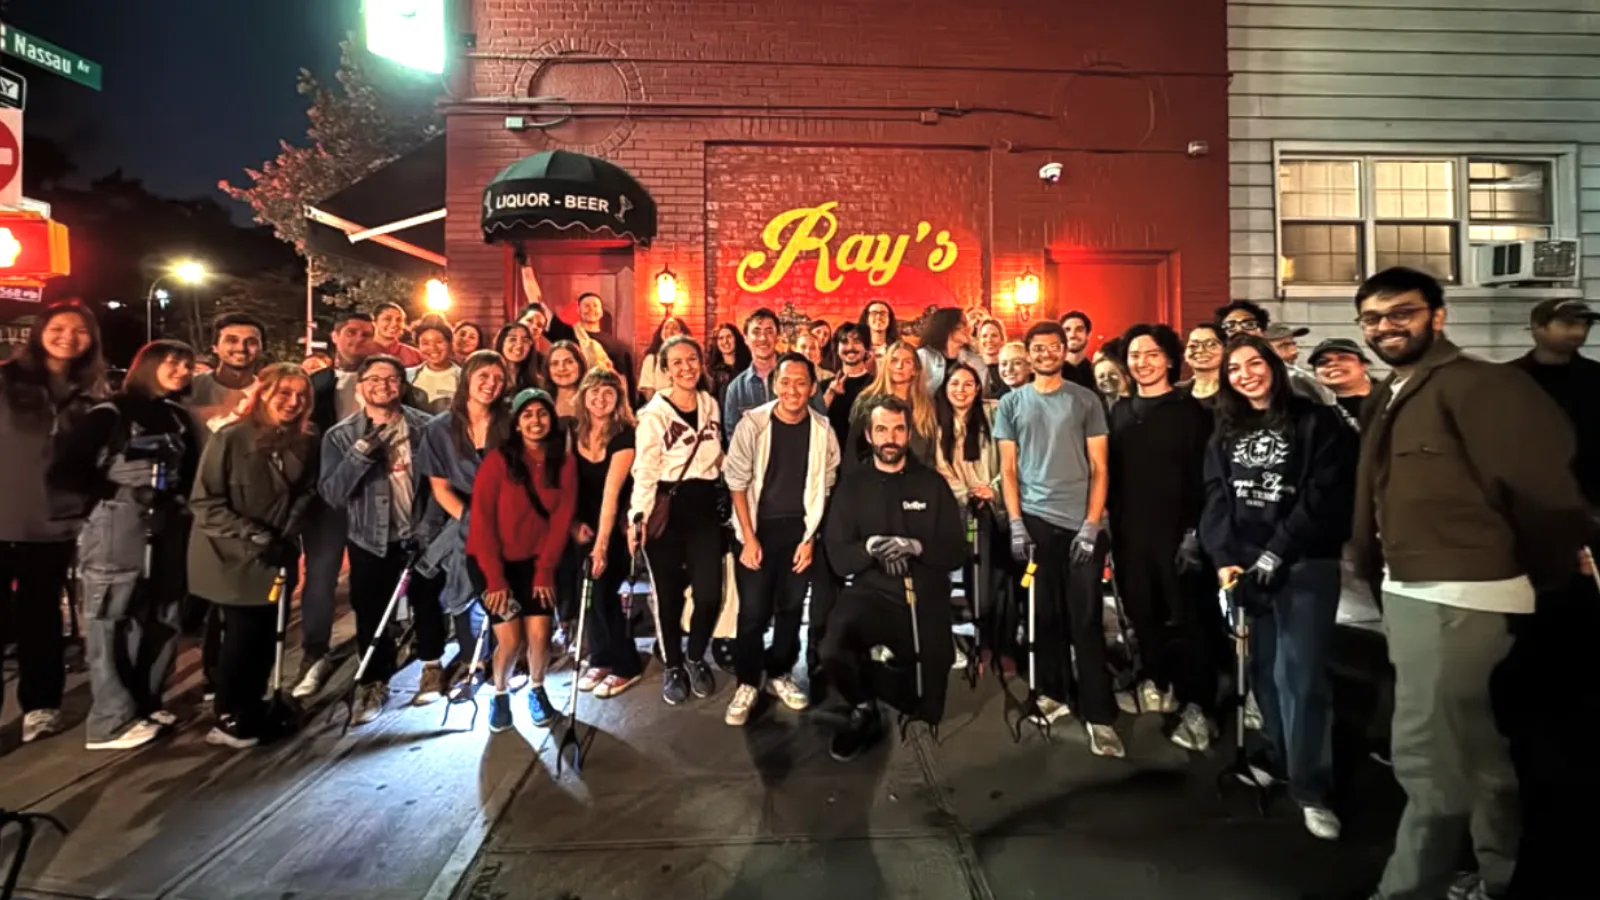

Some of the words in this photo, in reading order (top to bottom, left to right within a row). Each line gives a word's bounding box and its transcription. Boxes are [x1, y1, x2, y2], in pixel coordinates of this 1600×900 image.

[14, 33, 71, 74] Nassau
[496, 193, 550, 209] LIQUOR
[564, 194, 609, 213] BEER
[736, 201, 958, 293] Ray's
